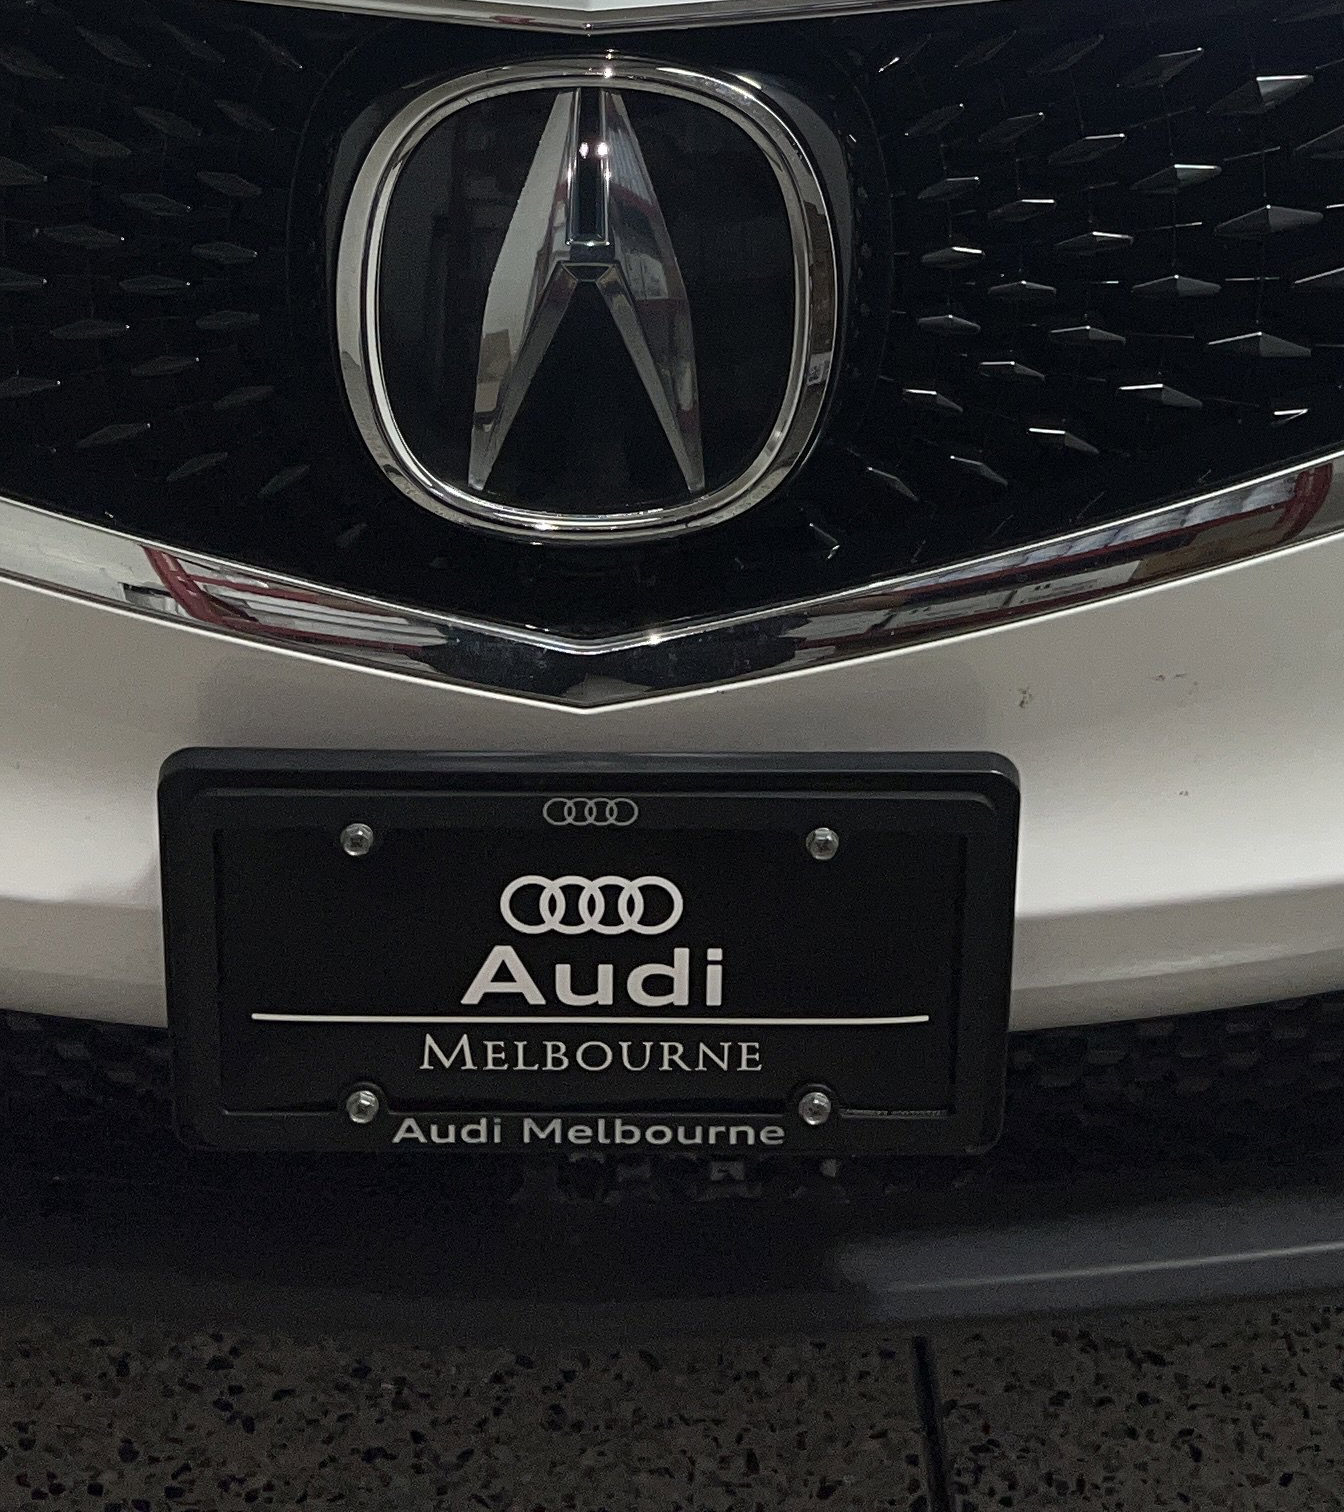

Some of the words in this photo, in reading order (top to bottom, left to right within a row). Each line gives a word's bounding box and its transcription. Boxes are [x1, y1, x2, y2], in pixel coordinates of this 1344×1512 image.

[460, 944, 724, 1007] Audi
[419, 1032, 764, 1072] MELBOURNE
[391, 1116, 502, 1145] Audi
[522, 1116, 786, 1146] Melbourne
